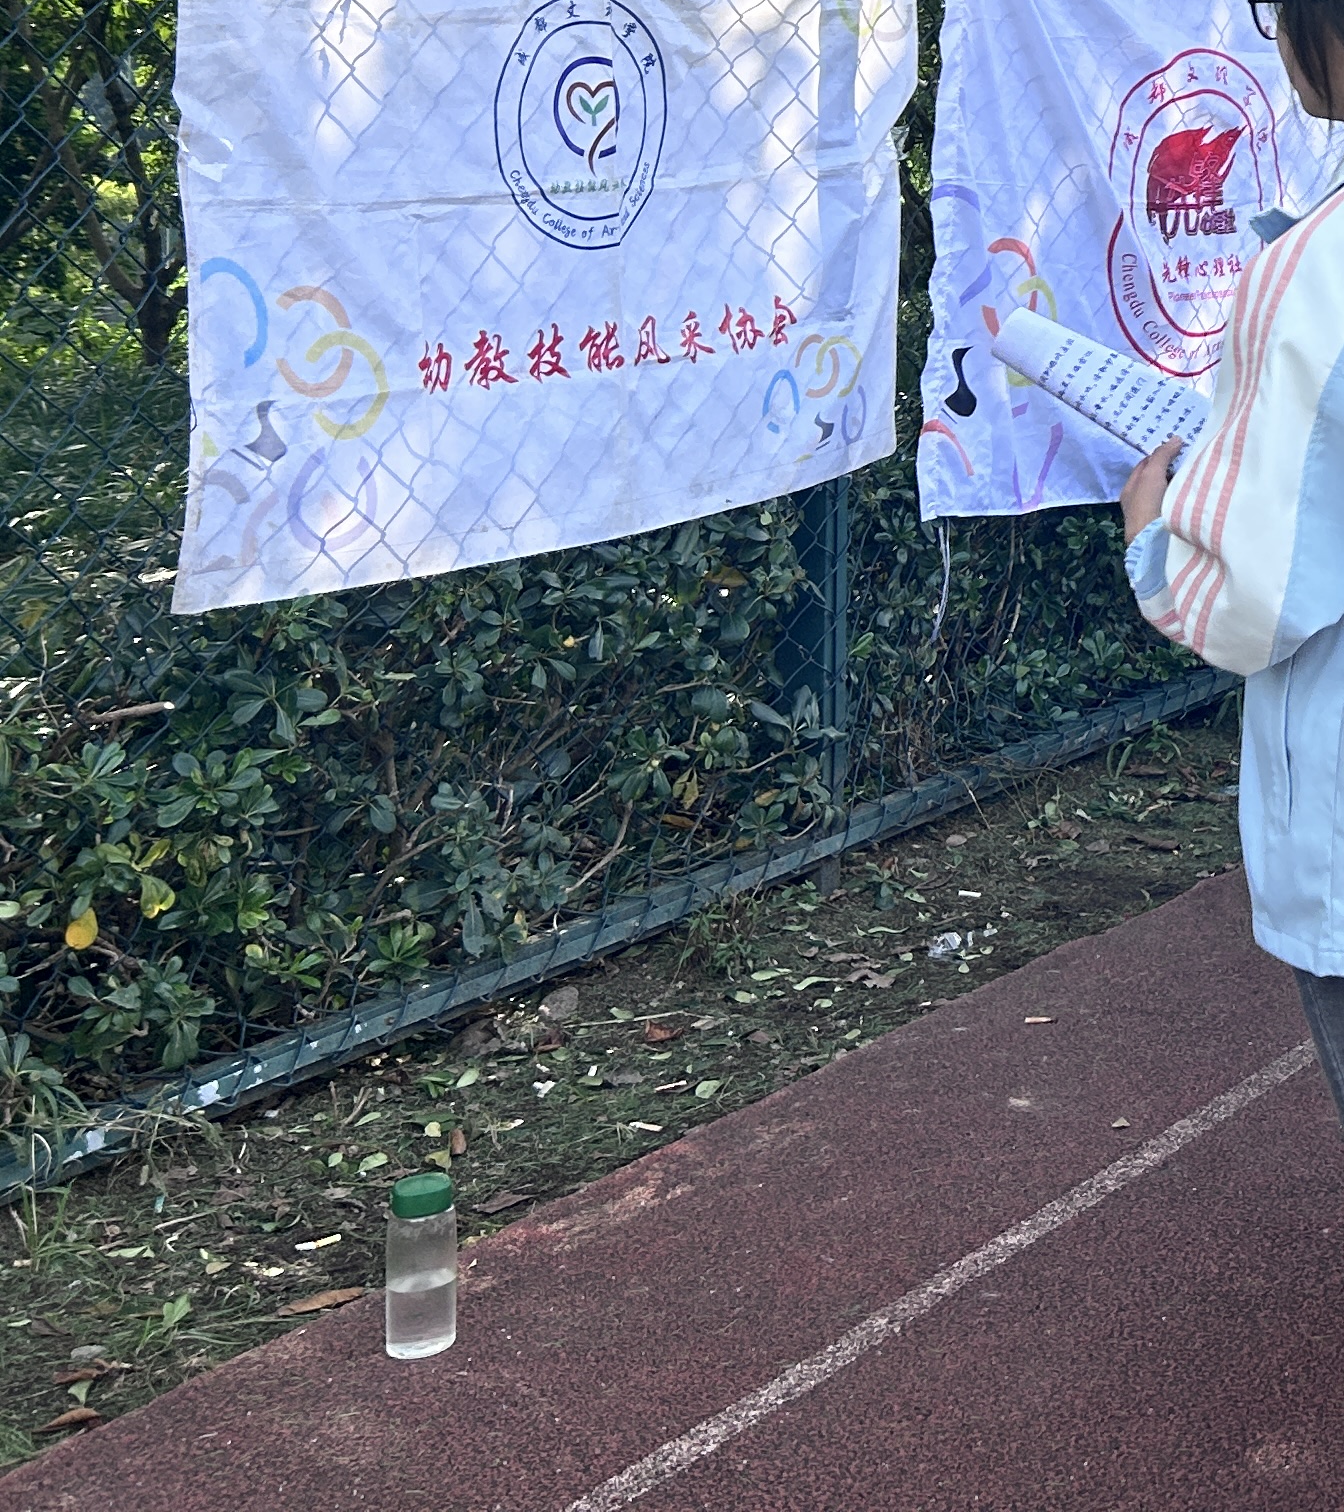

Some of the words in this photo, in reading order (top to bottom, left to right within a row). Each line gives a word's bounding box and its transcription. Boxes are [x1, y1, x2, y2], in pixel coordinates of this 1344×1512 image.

[542, 213, 577, 238] College
[581, 226, 595, 242] of
[629, 161, 651, 208] Sciences
[1121, 253, 1146, 319] Chengdu
[418, 296, 797, 395] 幼教技能风采协会
